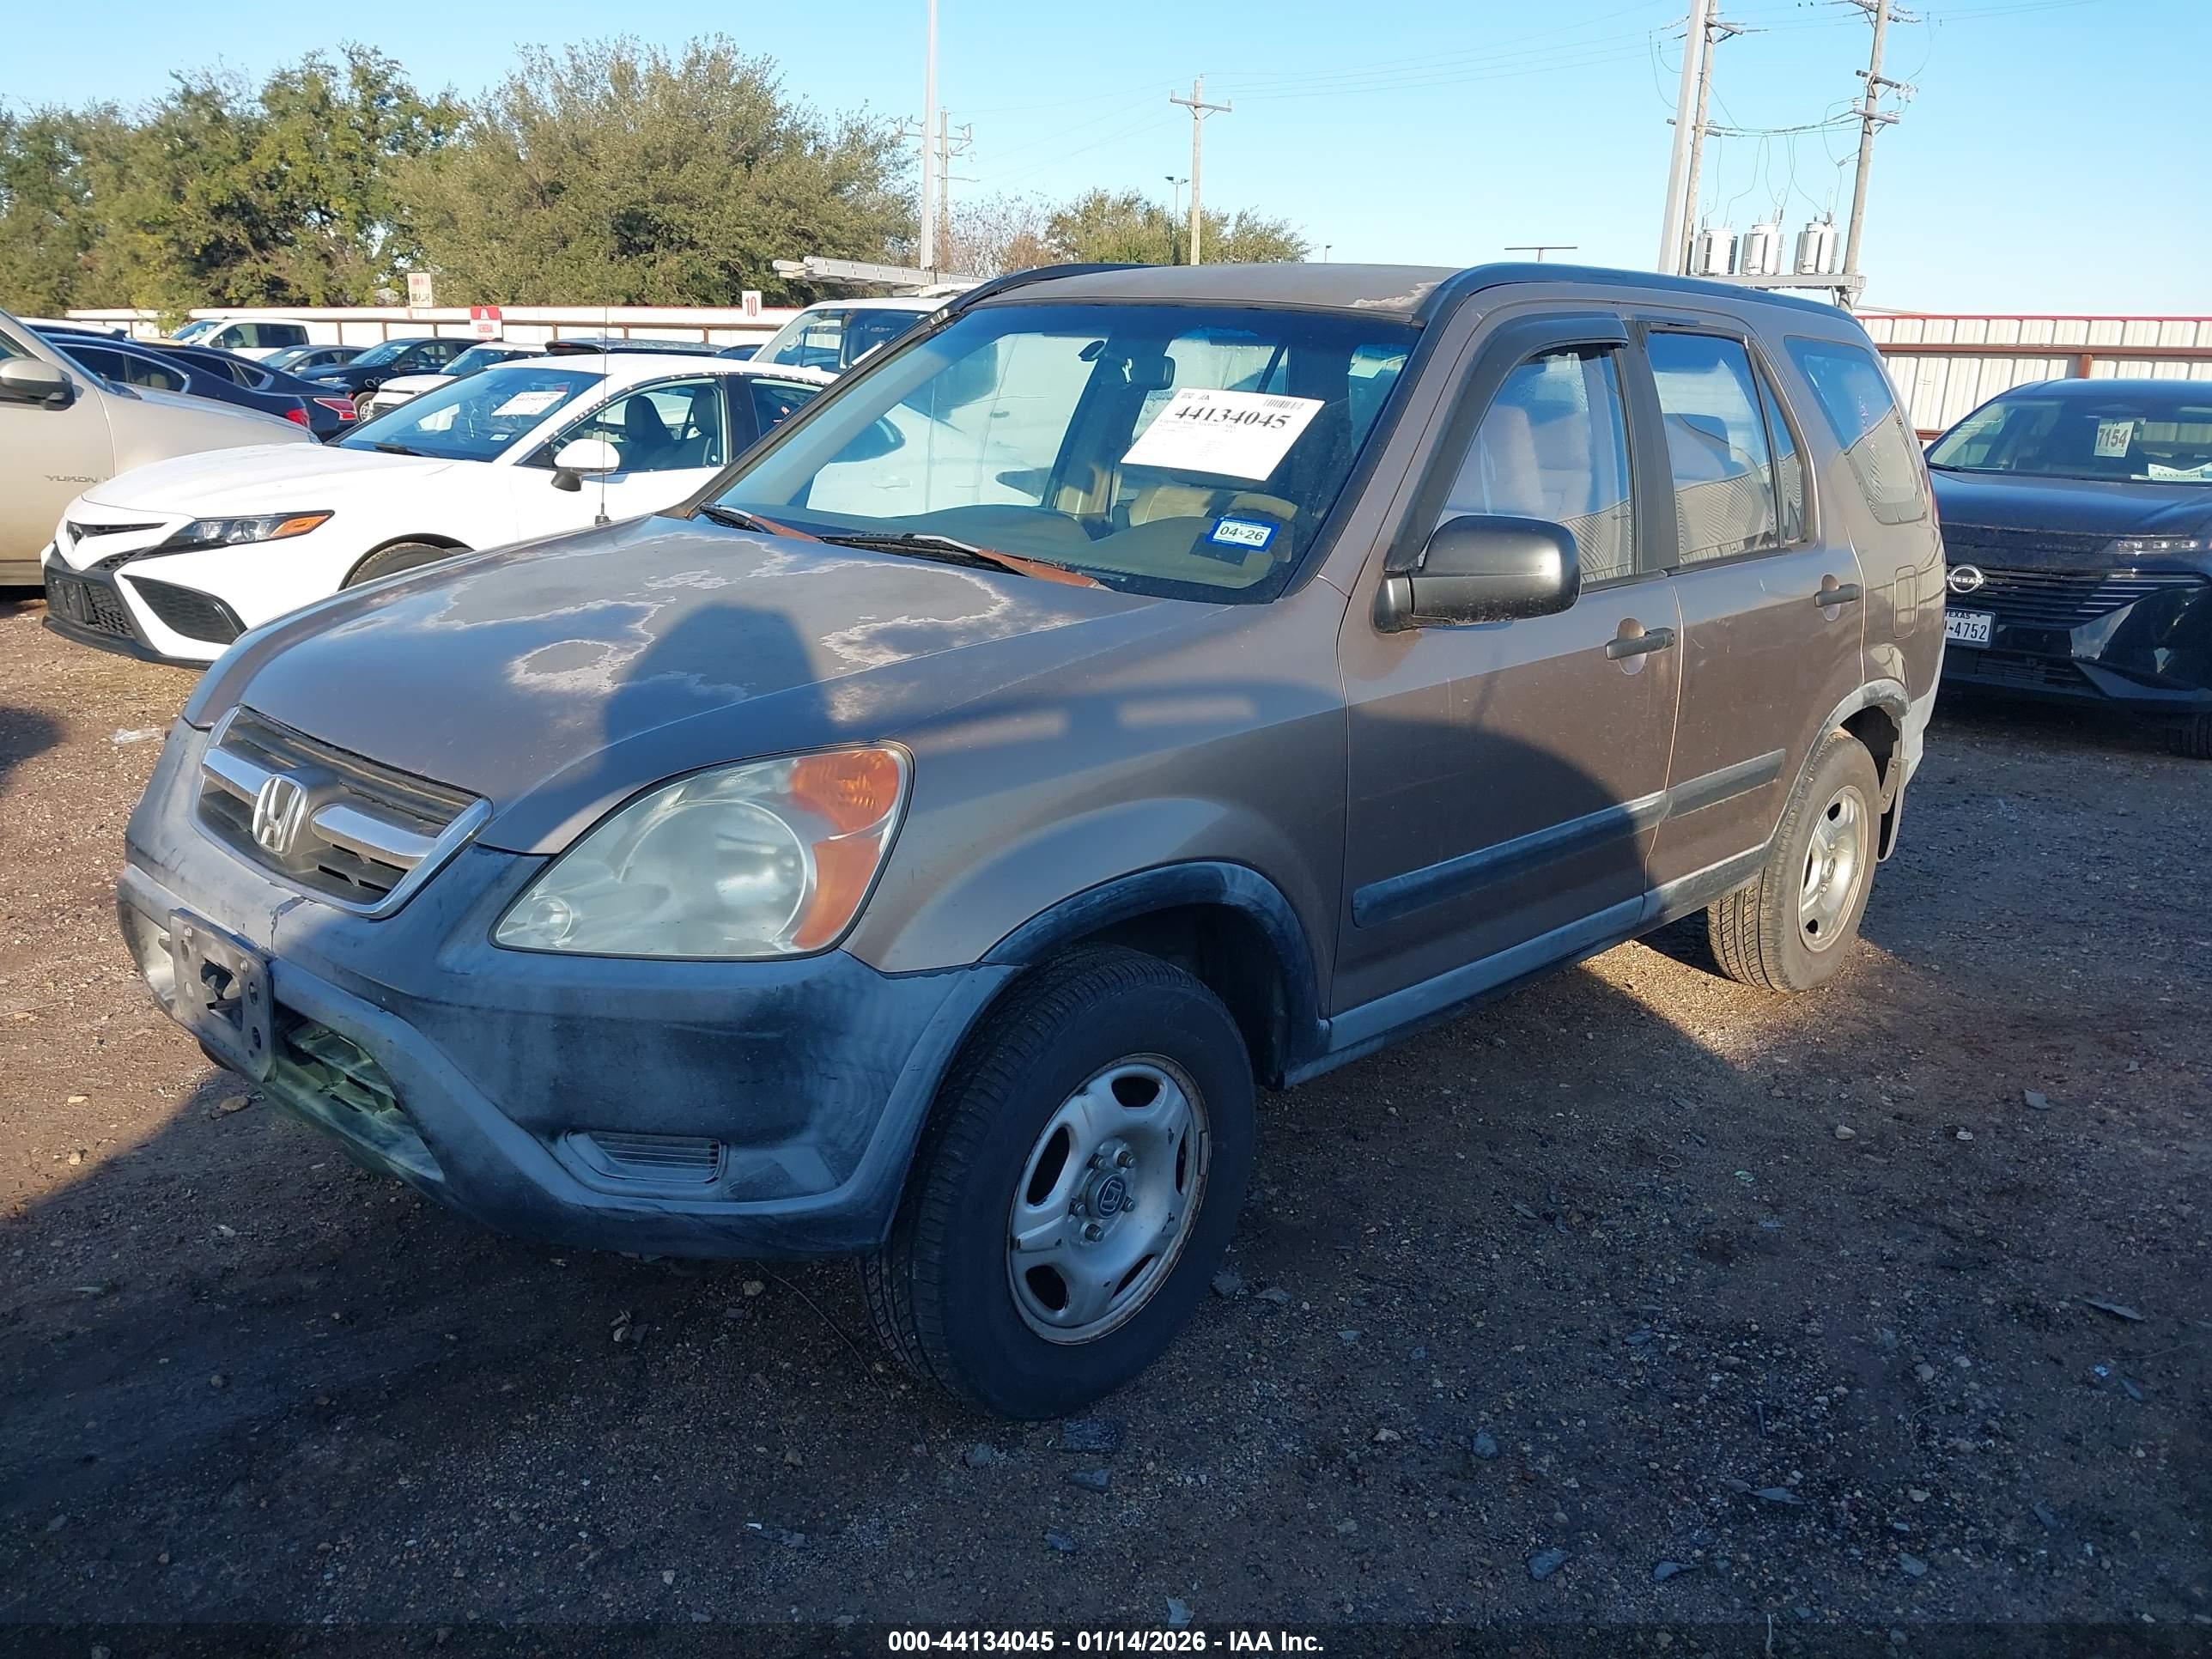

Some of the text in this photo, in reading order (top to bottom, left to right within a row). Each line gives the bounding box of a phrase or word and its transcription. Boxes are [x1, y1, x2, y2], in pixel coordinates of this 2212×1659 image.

[744, 296, 757, 317] 10
[1174, 405, 1291, 429] 44134045
[2097, 428, 2129, 447] 7154
[44, 475, 98, 483] YUKON
[1946, 575, 1984, 585] NISSAN
